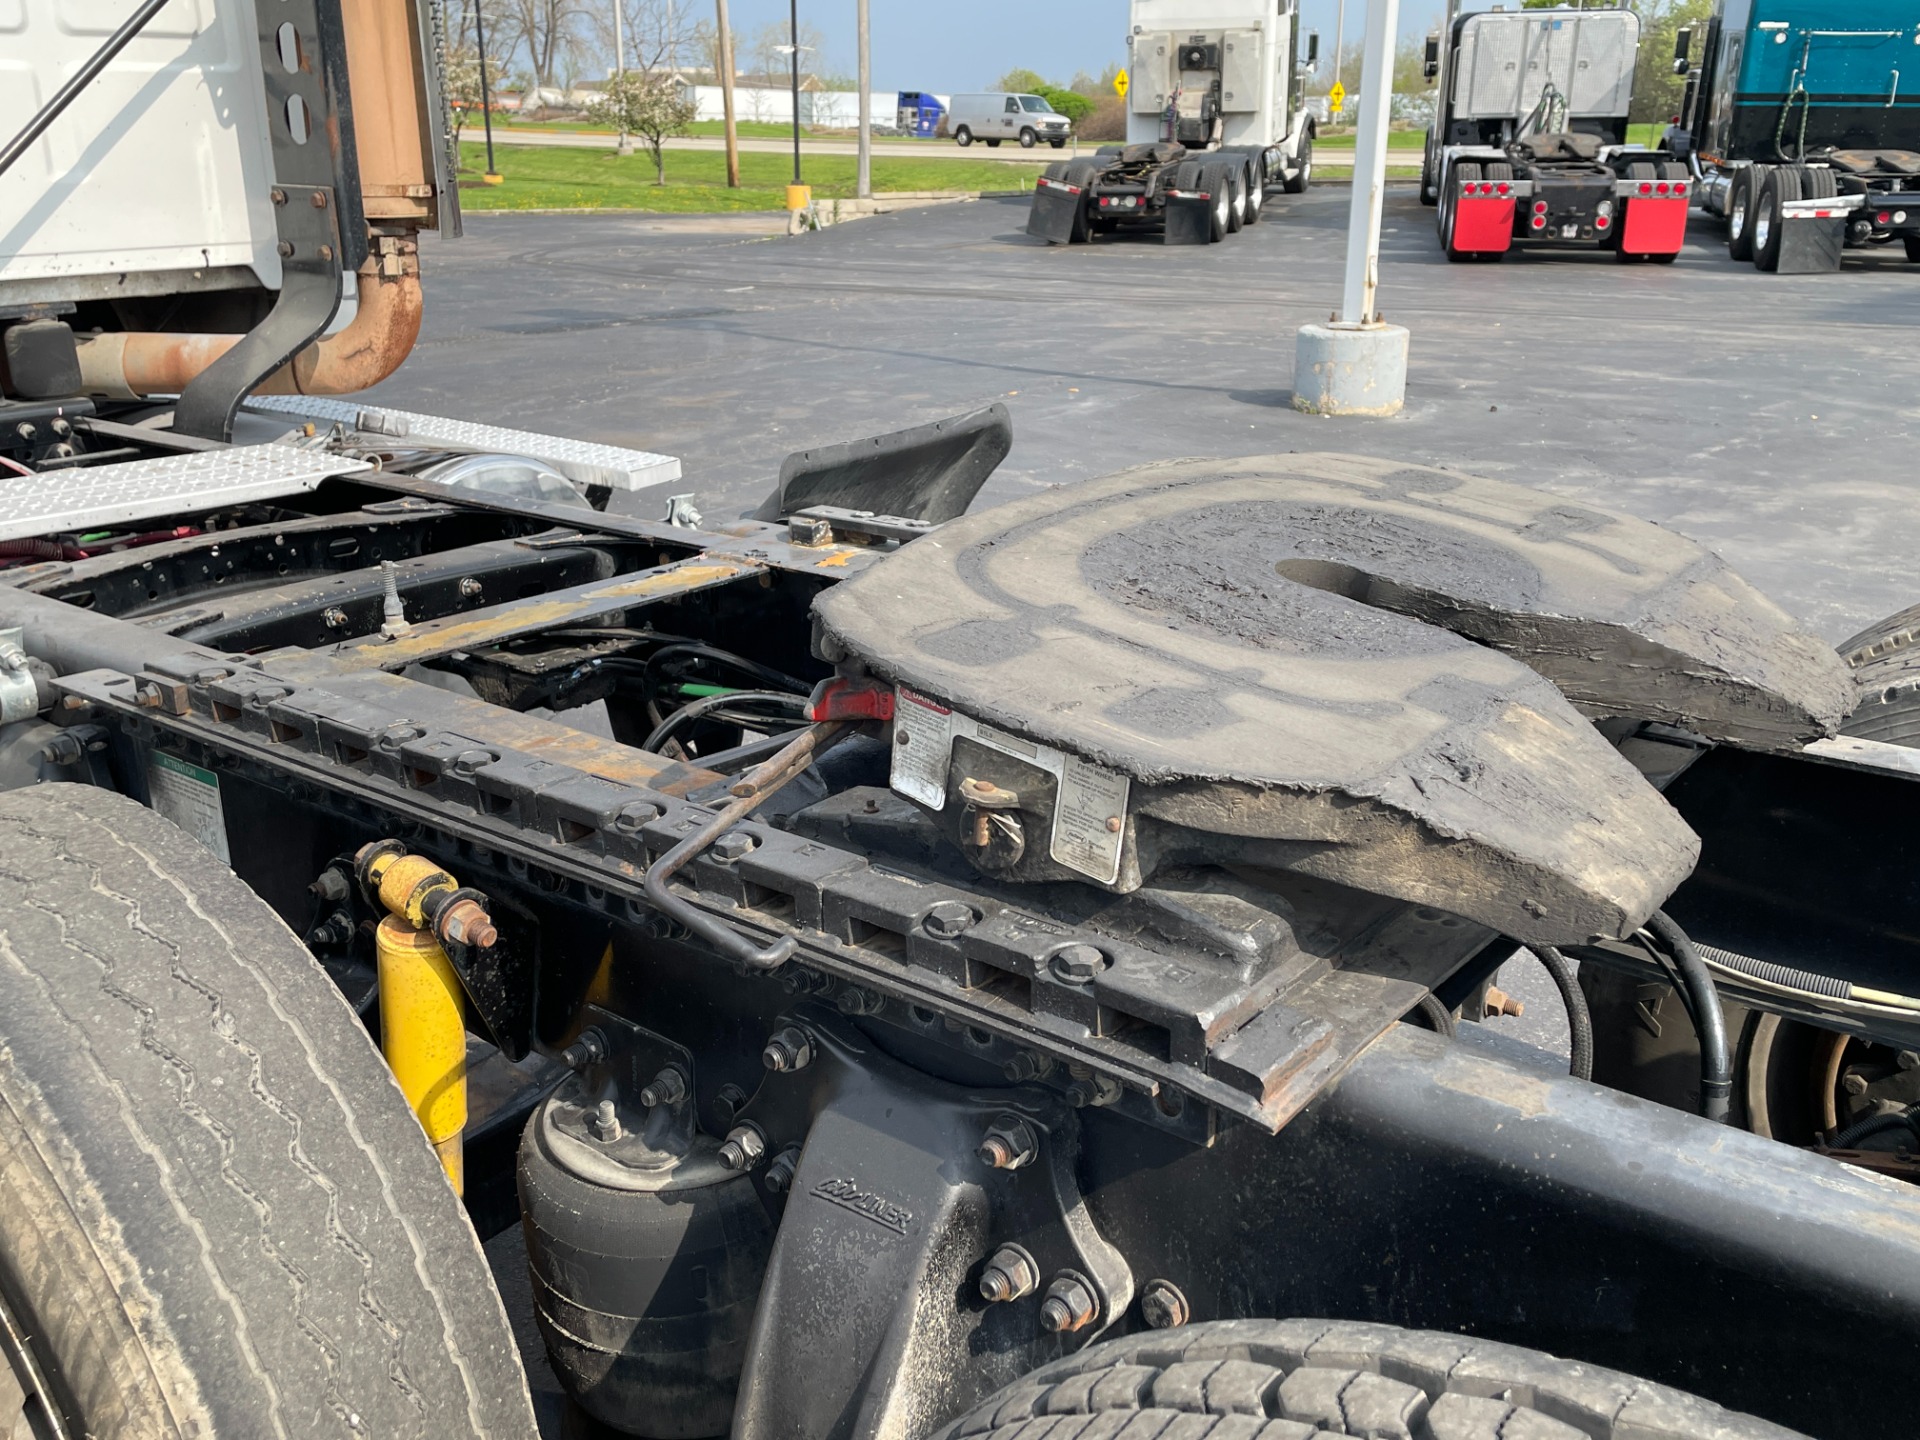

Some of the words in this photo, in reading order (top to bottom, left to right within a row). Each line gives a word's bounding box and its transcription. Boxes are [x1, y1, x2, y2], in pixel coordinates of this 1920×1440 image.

[913, 692, 948, 712] DANG
[164, 758, 196, 777] ATTENTION
[1077, 763, 1093, 773] FIFTH
[1095, 770, 1115, 782] WHEEL
